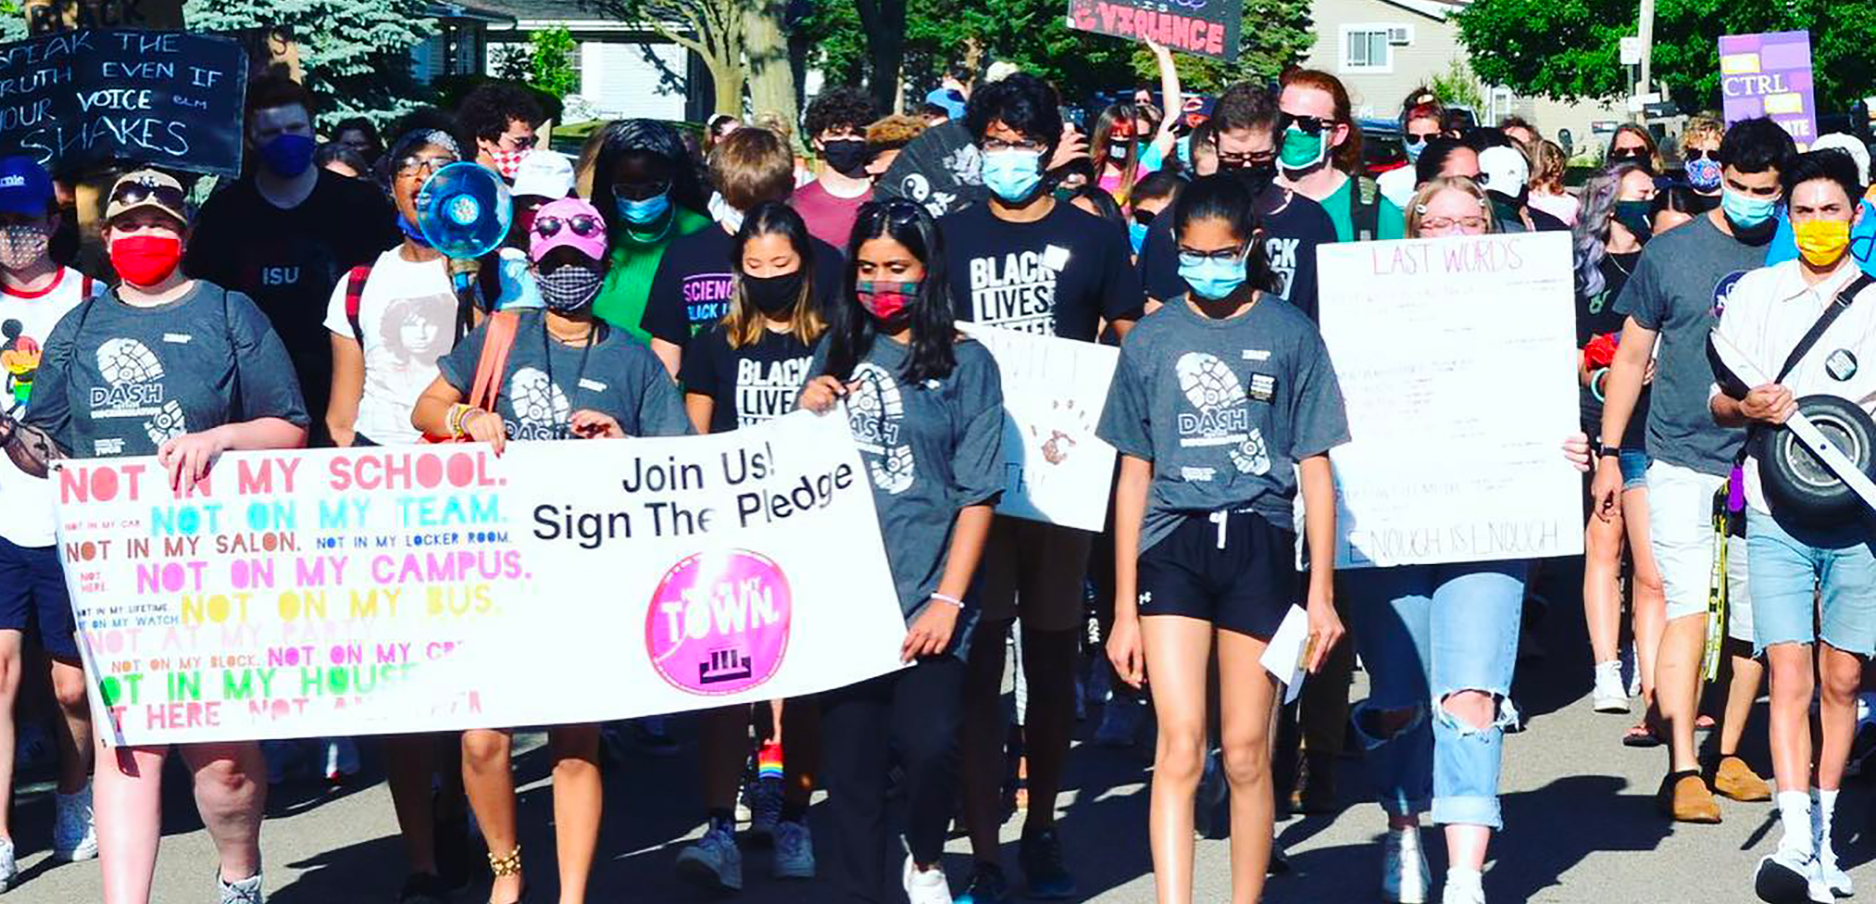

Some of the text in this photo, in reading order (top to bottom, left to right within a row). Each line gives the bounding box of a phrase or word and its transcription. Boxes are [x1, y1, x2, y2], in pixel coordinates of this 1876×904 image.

[113, 33, 180, 53] THE
[1099, 3, 1225, 55] VIOLENCE
[0, 61, 222, 98] RUTH EVEN IF
[1724, 75, 1789, 96] CTRL
[0, 97, 56, 132] OUR
[77, 88, 152, 112] VOICE
[20, 116, 189, 166] SHAKES
[1777, 119, 1810, 137] ATE
[969, 250, 1057, 290] BLACK
[1372, 238, 1523, 276] LAST WORDS
[262, 267, 299, 285] ISU
[980, 285, 1050, 321] LIVES
[737, 357, 813, 387] BLACK
[91, 382, 163, 407] DASH
[743, 388, 793, 415] LIVE
[849, 411, 899, 445] ASH
[1178, 408, 1248, 434] DASH
[59, 464, 146, 505] NOT
[238, 457, 301, 495] MY
[329, 452, 507, 491] SCHOOL.
[622, 440, 775, 493] Join Us!
[151, 502, 223, 536] NOT
[247, 500, 296, 532] ON
[319, 497, 370, 529] MY
[533, 463, 854, 549] Sign The Pledge
[65, 531, 301, 565] NOT IN MY SALON.
[317, 531, 513, 549] NOT IN MY LOCKER ROOM.
[136, 550, 532, 595] NOT ON MY CAMPUS.
[92, 618, 107, 629] ON
[112, 617, 129, 628] MY
[135, 614, 179, 627] WATCH
[181, 593, 254, 626] NOT
[278, 589, 328, 623] ON
[349, 587, 402, 618] MY
[86, 627, 143, 655] NOT
[267, 646, 315, 668] NOT
[330, 643, 363, 665] ON
[376, 641, 411, 663] MY
[111, 659, 141, 673] NOT
[150, 657, 170, 671] ON
[179, 656, 201, 670] MY
[100, 674, 143, 707] OT
[167, 670, 201, 702] IN
[223, 667, 276, 700] MY
[146, 701, 221, 731] HERE
